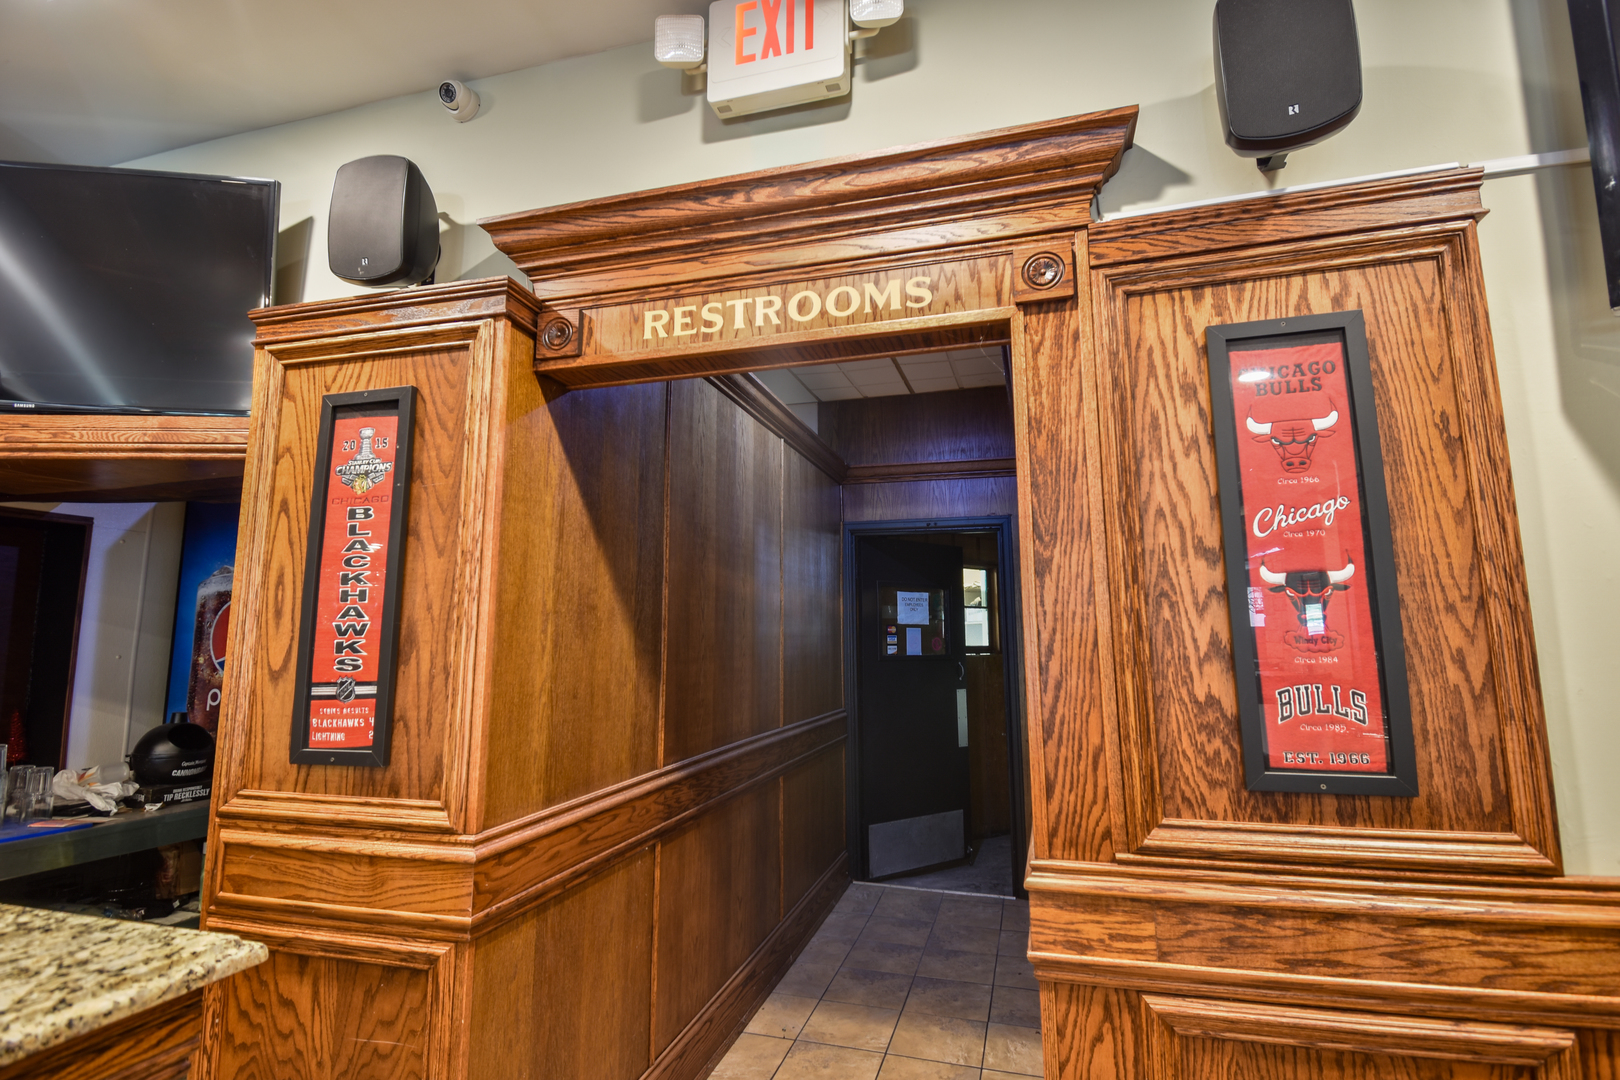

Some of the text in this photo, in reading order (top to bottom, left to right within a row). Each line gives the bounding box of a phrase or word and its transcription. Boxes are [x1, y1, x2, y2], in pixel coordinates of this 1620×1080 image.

[643, 276, 933, 339] RESTROOMS
[1255, 377, 1322, 396] BULLS
[342, 437, 389, 452] 20 15
[335, 462, 393, 475] CHAMPIONS
[1278, 477, 1297, 485] Circa
[331, 495, 390, 505] CHICAGO
[1253, 496, 1350, 538] Chicago
[1306, 529, 1325, 537] 1970
[332, 505, 376, 673] BLACKHAWKS
[1293, 635, 1338, 647] Windy City
[1294, 656, 1338, 664] Circa 1984
[1276, 684, 1368, 725] BULLS
[312, 718, 365, 728] BLACKHAWKS
[1300, 723, 1322, 731] Circa
[311, 731, 346, 742] LIGHTNING
[1283, 752, 1371, 765] EST. 1966
[163, 788, 211, 802] TIP RECKLESSLY
